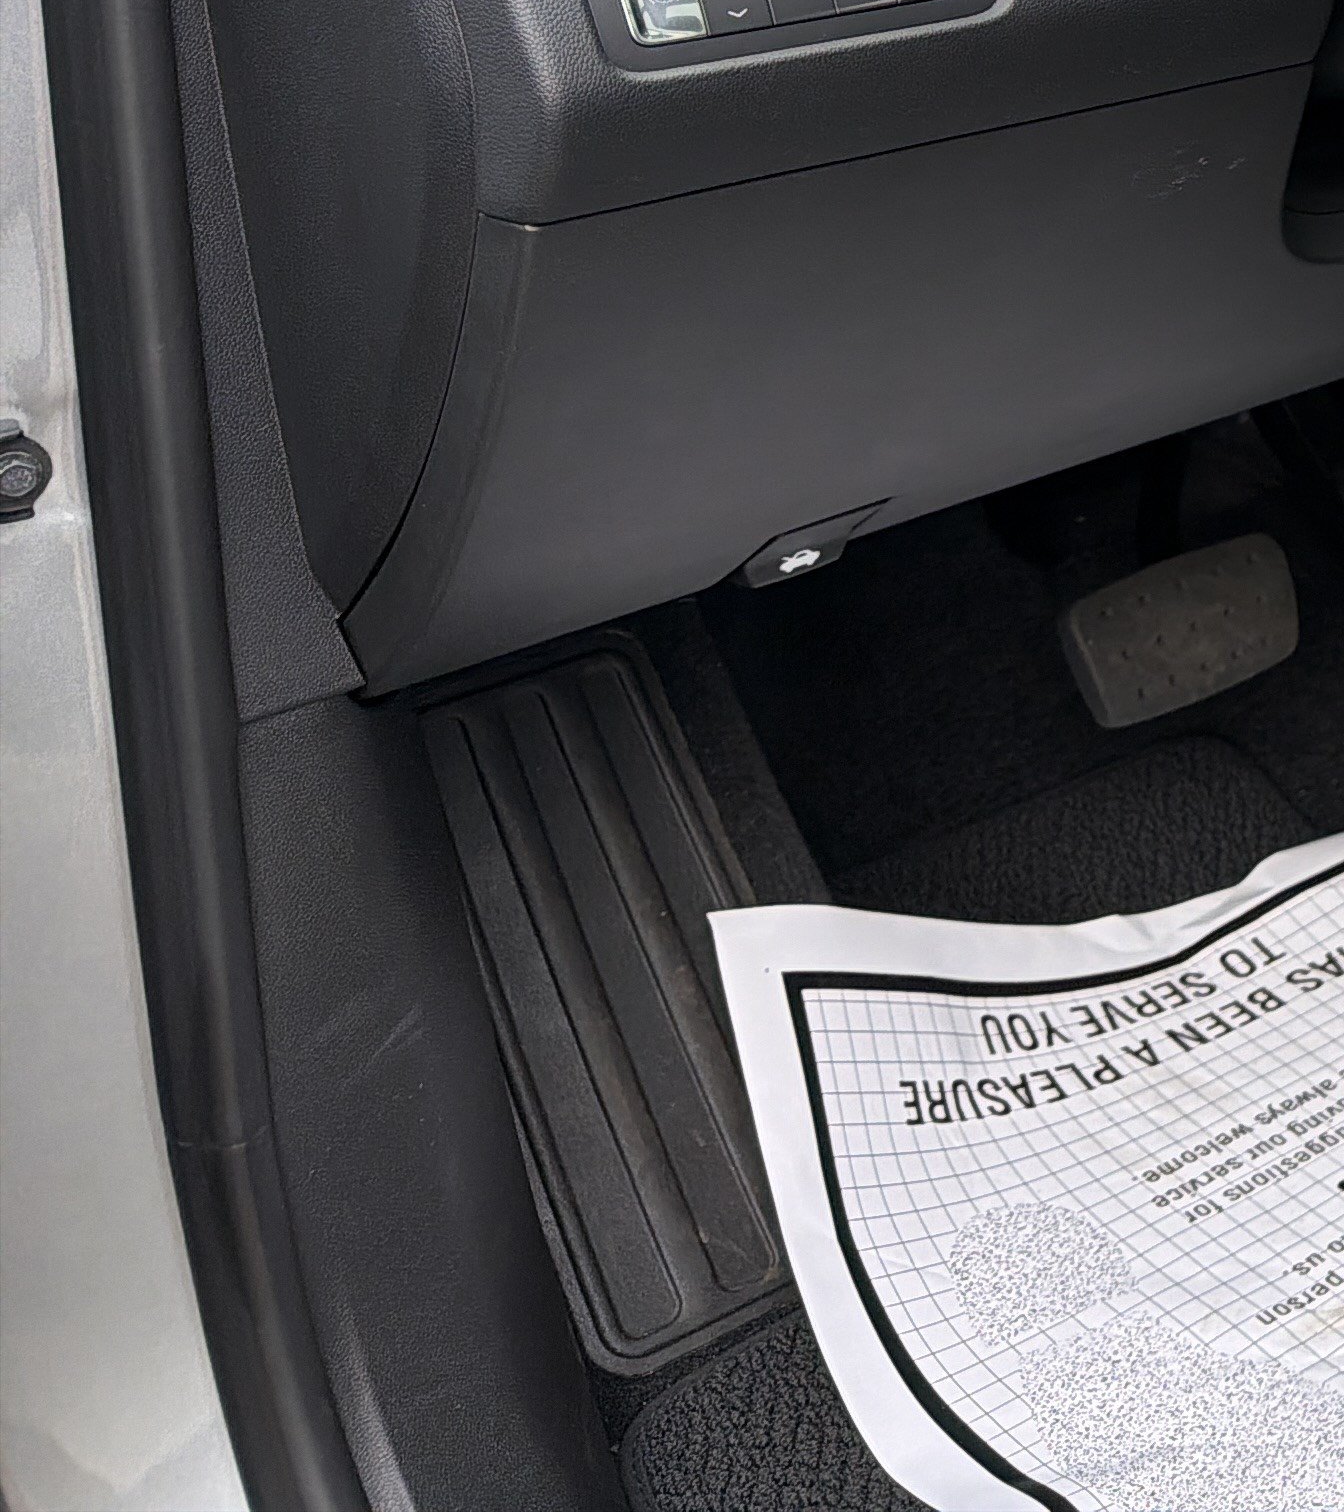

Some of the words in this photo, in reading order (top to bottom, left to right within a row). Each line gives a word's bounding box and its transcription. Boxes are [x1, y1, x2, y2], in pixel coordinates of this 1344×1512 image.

[1219, 936, 1287, 978] TO
[1070, 972, 1217, 1038] SERVE
[1165, 987, 1287, 1052] BEEN
[981, 1010, 1073, 1055] YOU
[1122, 1038, 1162, 1067] A
[900, 1054, 1124, 1125] PLEASURE
[1254, 1078, 1338, 1125] always
[1131, 1123, 1253, 1183] welcome.
[1249, 1135, 1287, 1160] our
[1151, 1156, 1244, 1208] service
[1184, 1198, 1224, 1224] for
[1283, 1250, 1326, 1276] us.
[1255, 1270, 1344, 1326] person
